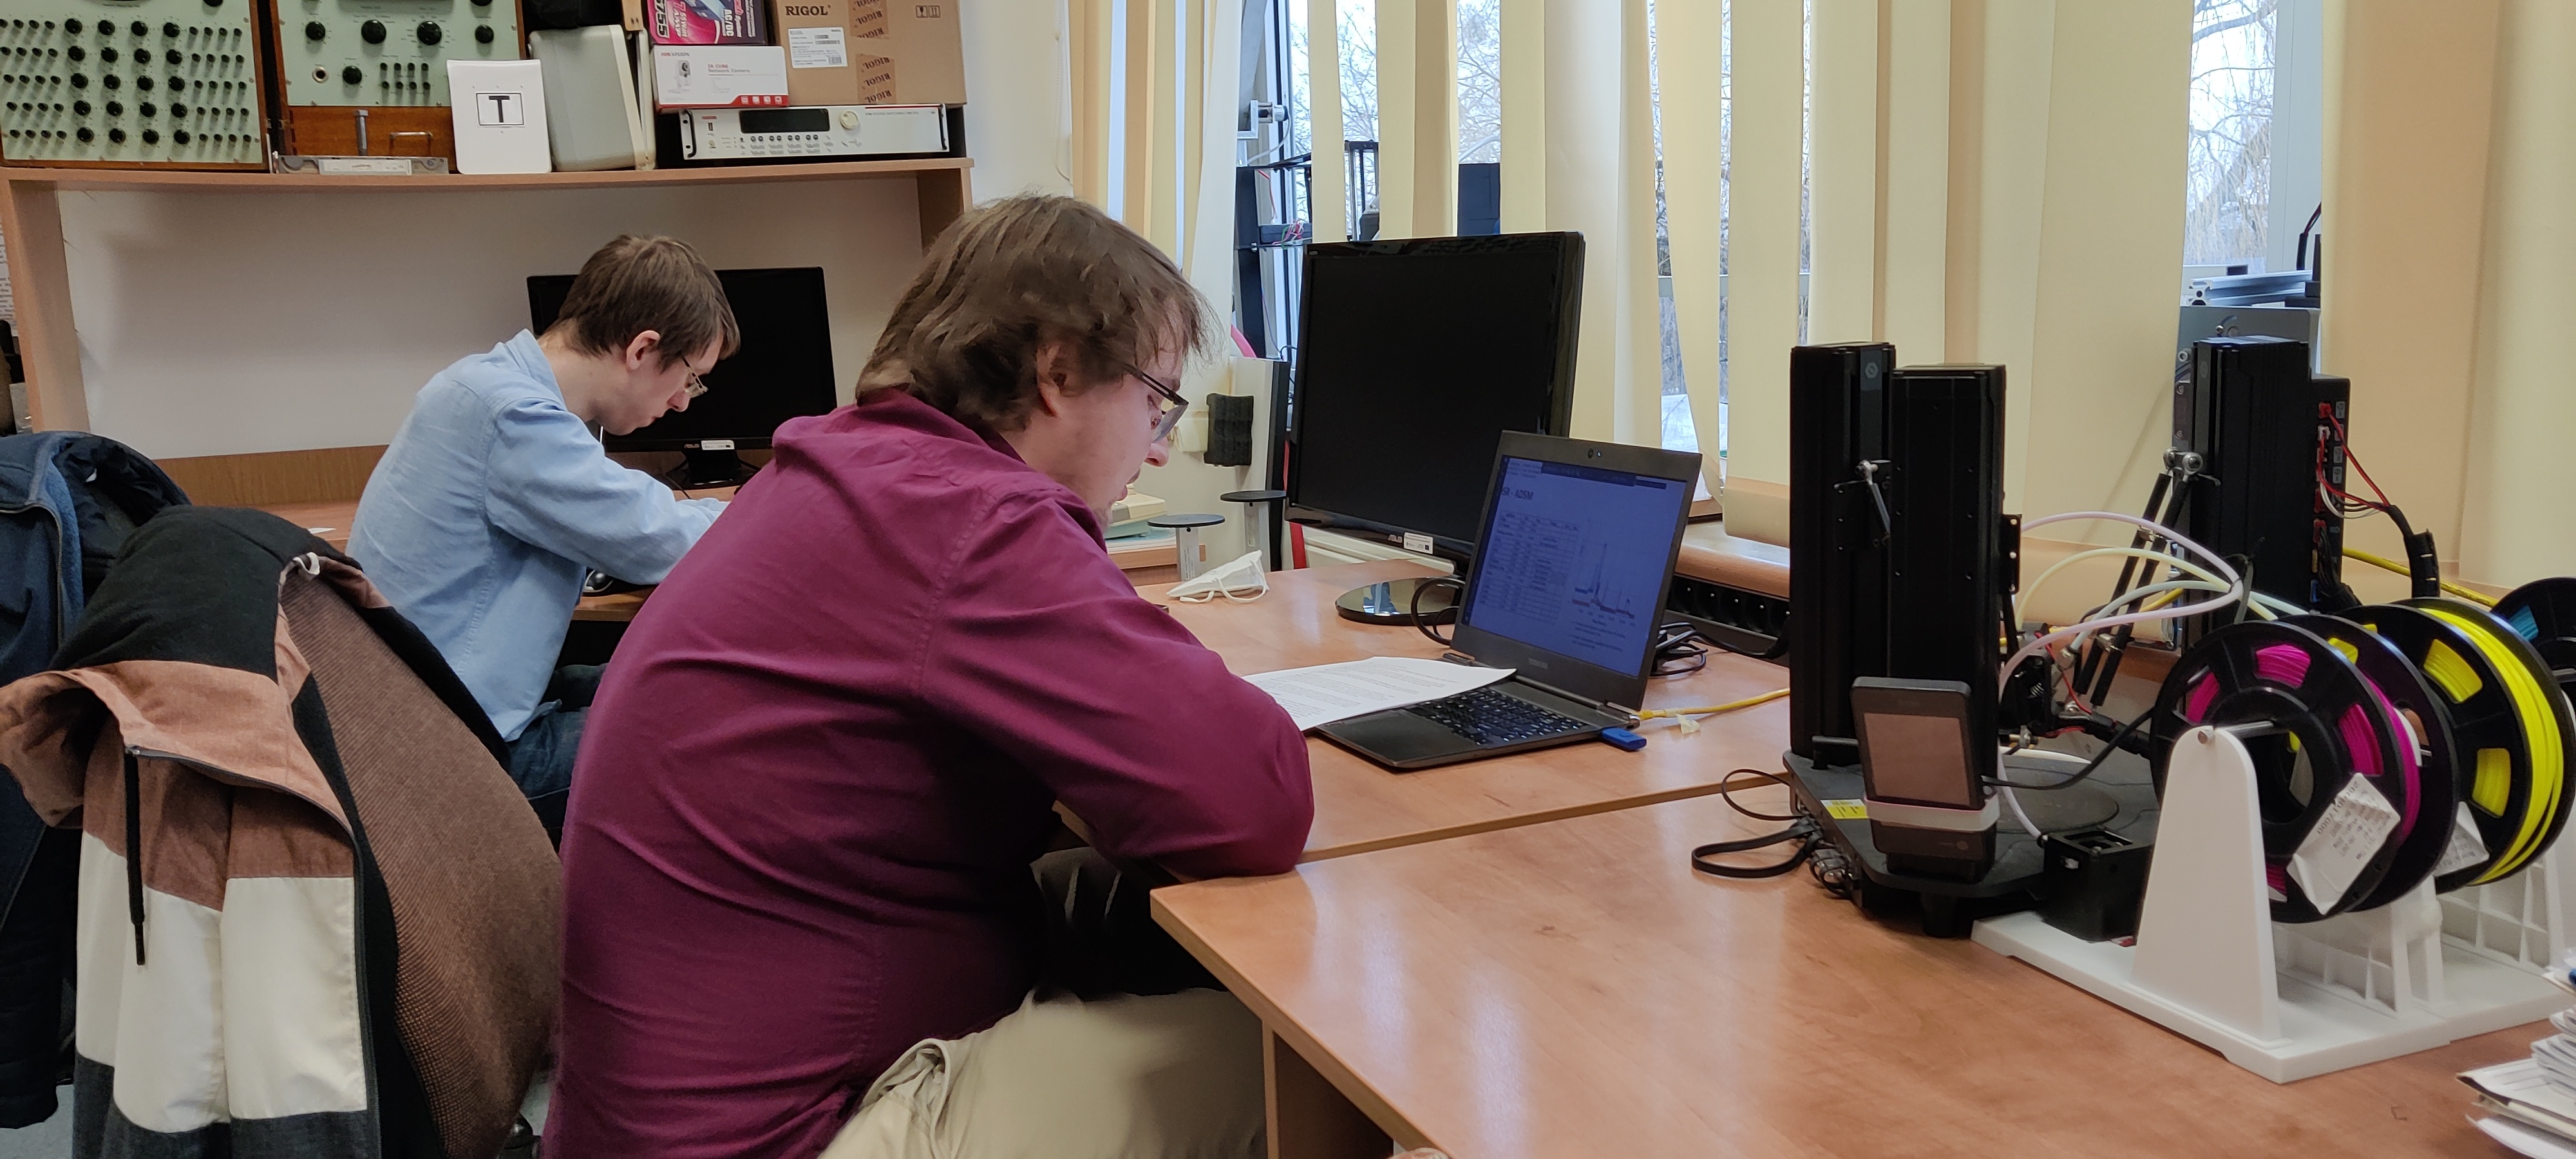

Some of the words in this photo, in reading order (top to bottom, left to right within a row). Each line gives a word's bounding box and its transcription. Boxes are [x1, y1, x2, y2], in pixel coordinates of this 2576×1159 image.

[785, 6, 828, 16] RIGOL
[855, 10, 883, 25] RIGOL
[673, 8, 681, 37] AMP
[724, 9, 734, 37] AC/DC
[863, 57, 891, 70] RIGOL
[864, 72, 891, 87] RIGOL
[864, 89, 893, 103] RIGOL
[488, 95, 510, 123] T
